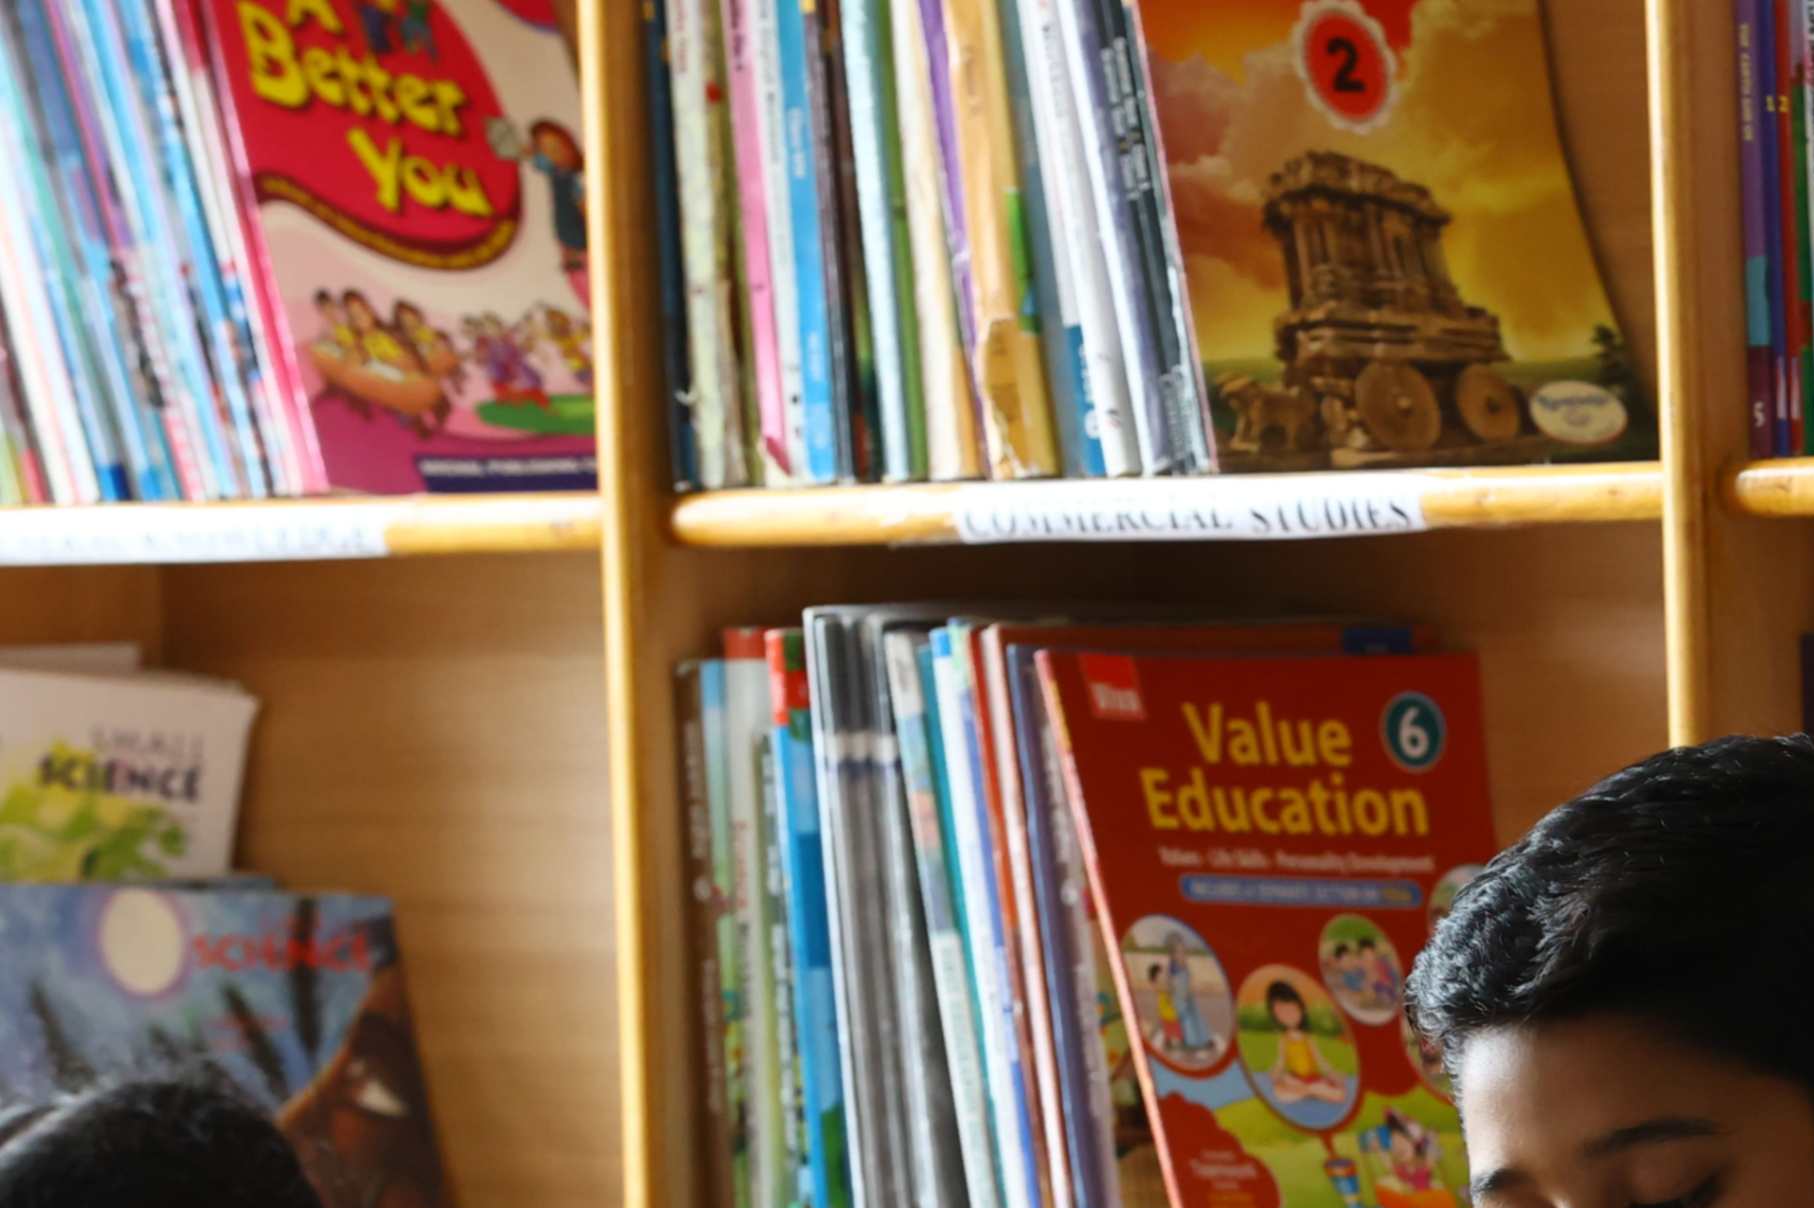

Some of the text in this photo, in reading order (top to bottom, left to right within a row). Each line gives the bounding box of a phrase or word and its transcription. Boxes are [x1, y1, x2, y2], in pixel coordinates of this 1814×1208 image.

[237, 2, 466, 135] Better
[1328, 39, 1367, 92] 2
[347, 129, 494, 216] You
[1250, 498, 1411, 535] STUDIES
[1181, 700, 1352, 767] Value
[1399, 706, 1431, 758] 6
[38, 749, 201, 801] SCIENCE
[1140, 767, 1431, 836] Education
[193, 930, 373, 973] SCIENCE
